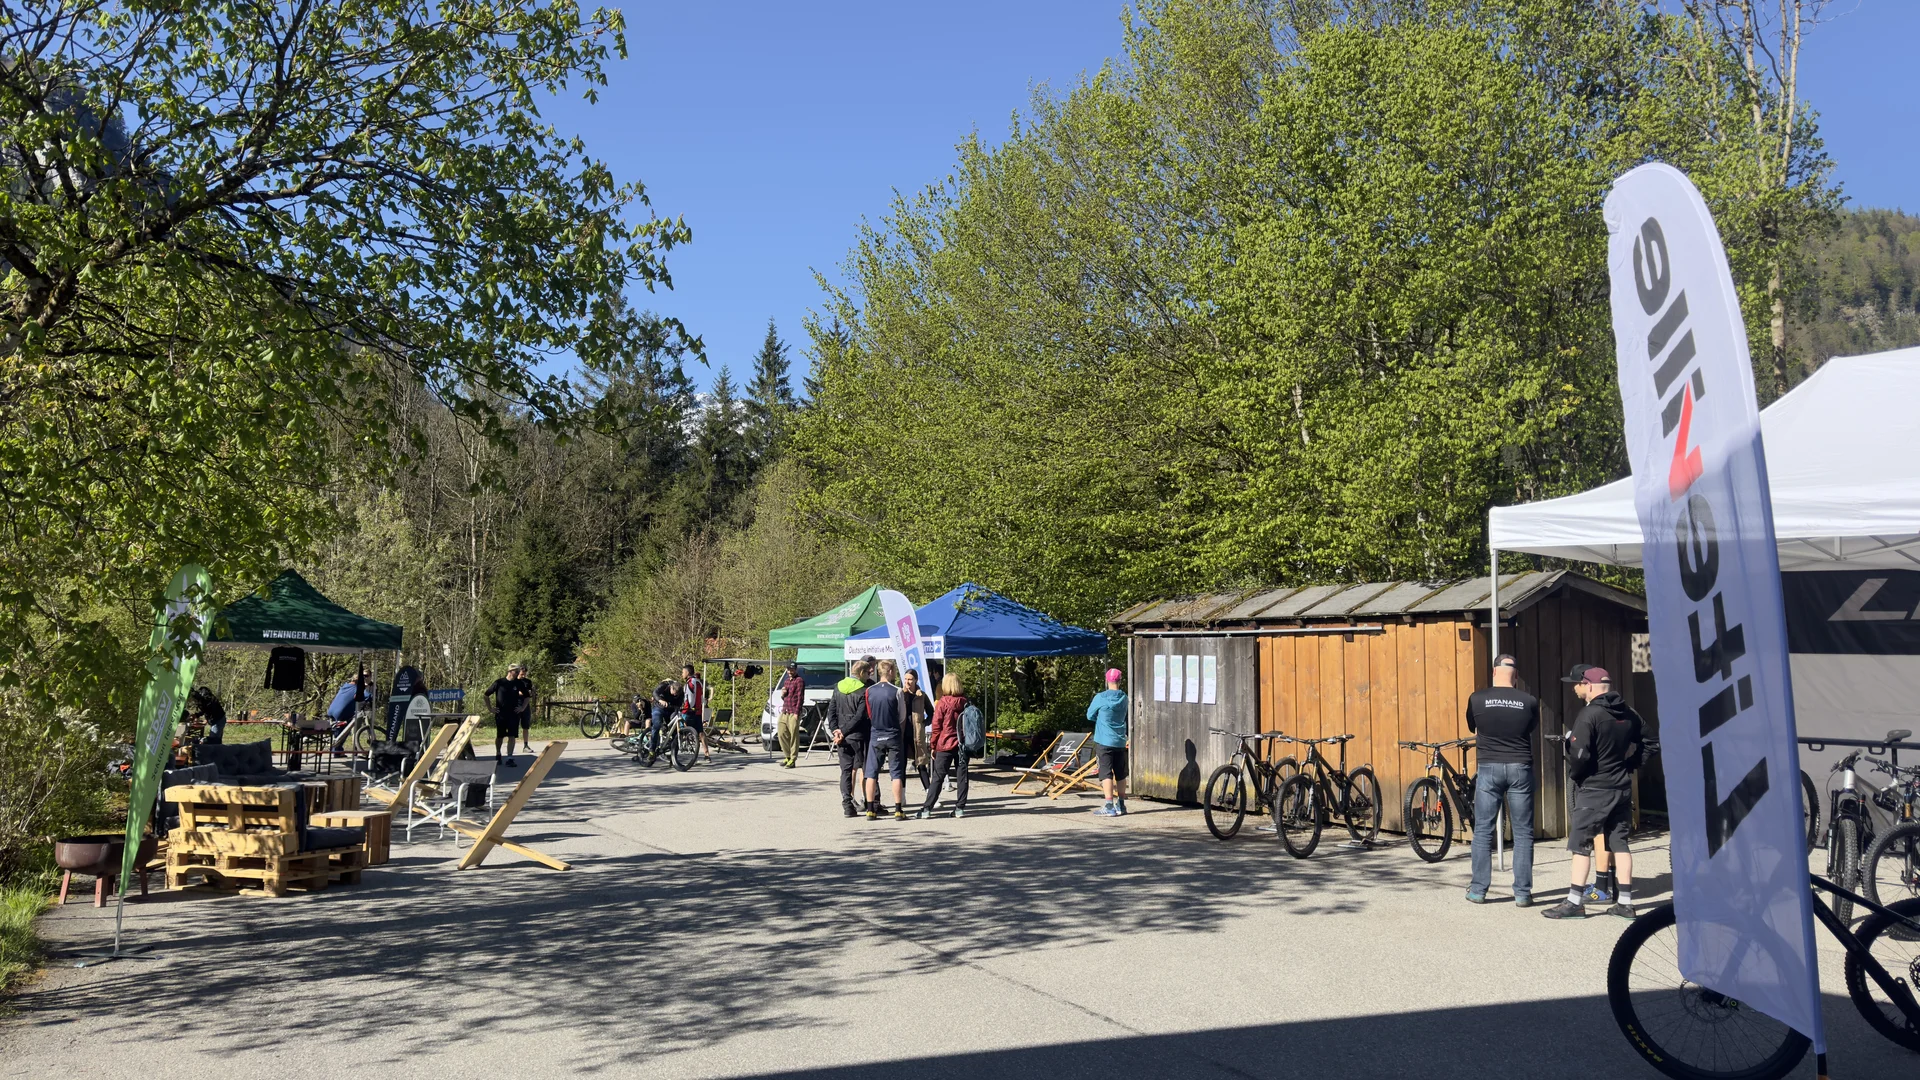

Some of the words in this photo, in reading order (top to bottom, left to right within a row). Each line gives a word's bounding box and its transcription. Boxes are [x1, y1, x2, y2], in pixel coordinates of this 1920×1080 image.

[1827, 578, 1920, 621] L
[262, 629, 320, 641] WIENINGER.DE
[428, 690, 460, 700] Ausfahrt
[1485, 699, 1524, 707] MITANAND
[151, 694, 168, 733] DAV
